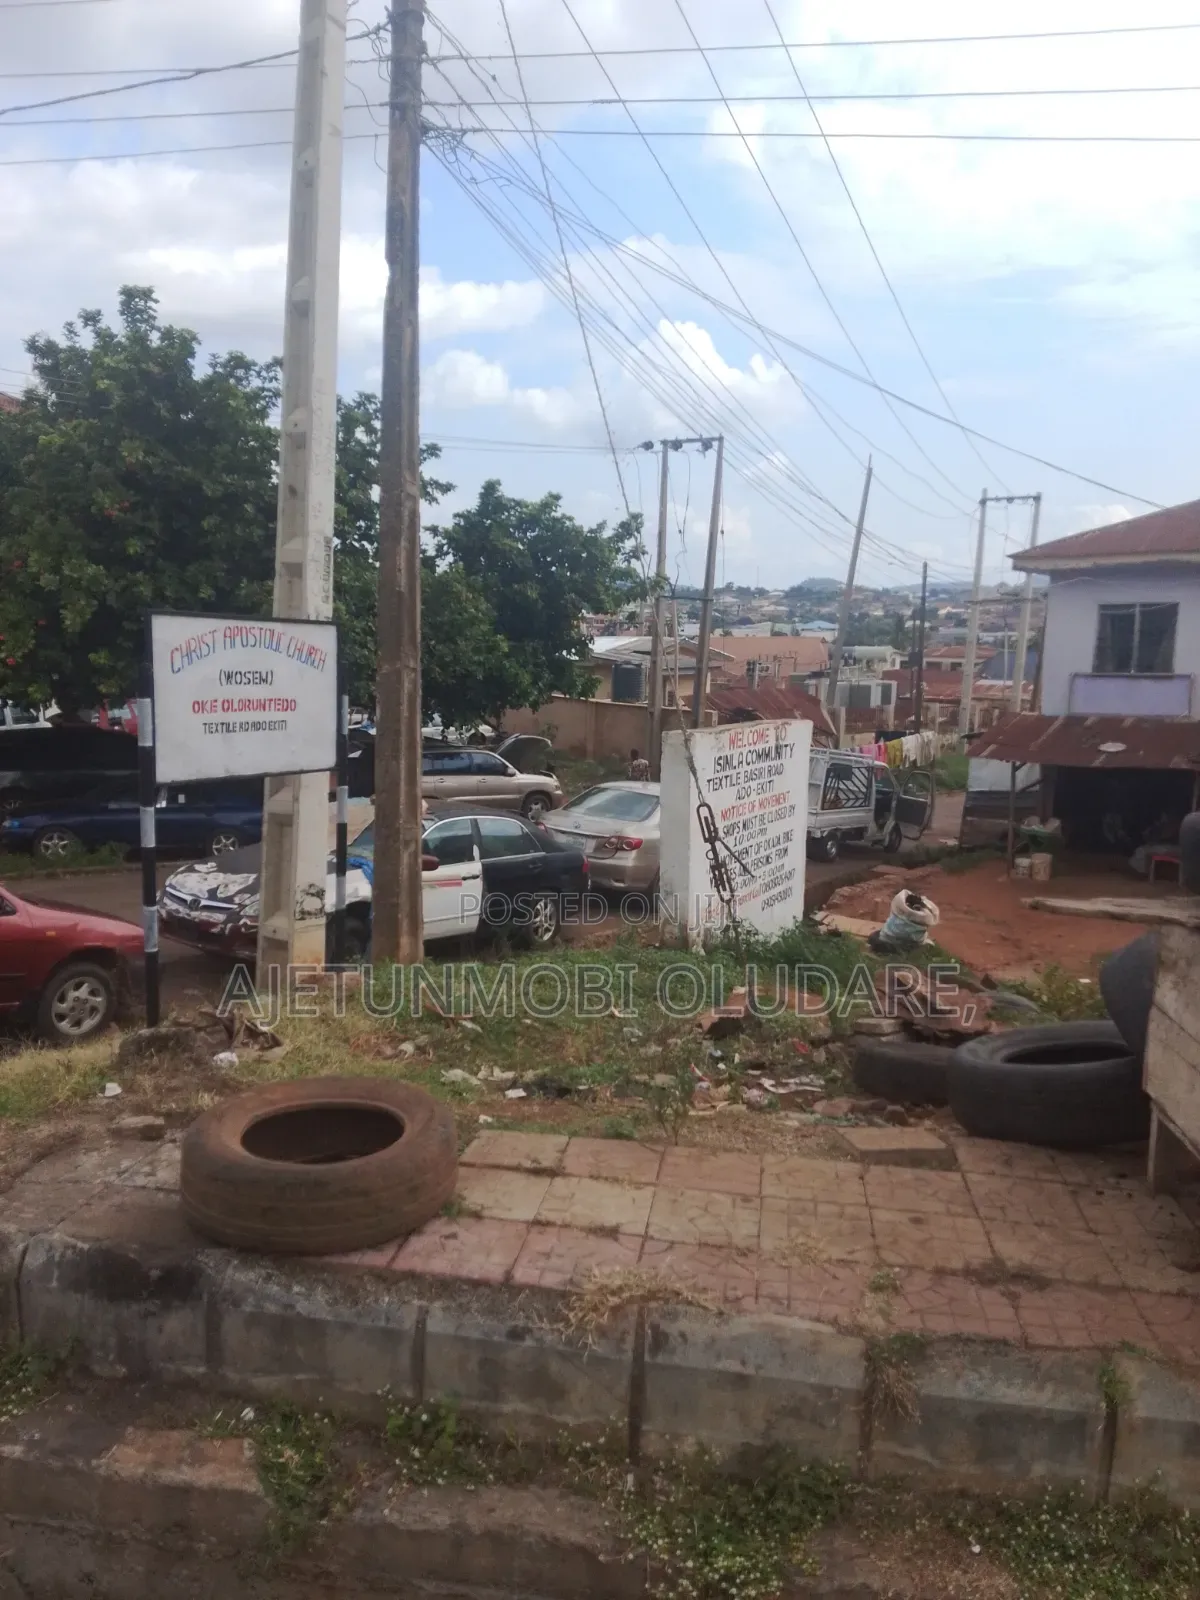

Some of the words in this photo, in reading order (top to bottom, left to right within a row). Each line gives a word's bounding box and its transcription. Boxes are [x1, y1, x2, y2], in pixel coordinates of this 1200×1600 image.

[170, 629, 217, 674] CHRIST
[286, 635, 328, 672] CHURCH
[218, 669, 274, 686] (WOSEM)
[192, 699, 218, 714] OKE
[202, 721, 237, 735] TEXTILE
[728, 727, 770, 751] WELCOME
[745, 742, 795, 767] COMMUNITY
[743, 766, 766, 784] BASIRI
[766, 762, 784, 778] ROAD
[721, 804, 747, 823] NOTICE
[747, 799, 757, 814] OF
[758, 790, 791, 812] MOVEMENT
[741, 814, 758, 833] MUST
[758, 811, 766, 827] BE
[767, 805, 788, 824] CLOSED
[788, 803, 796, 818] BY
[753, 841, 763, 856] OF
